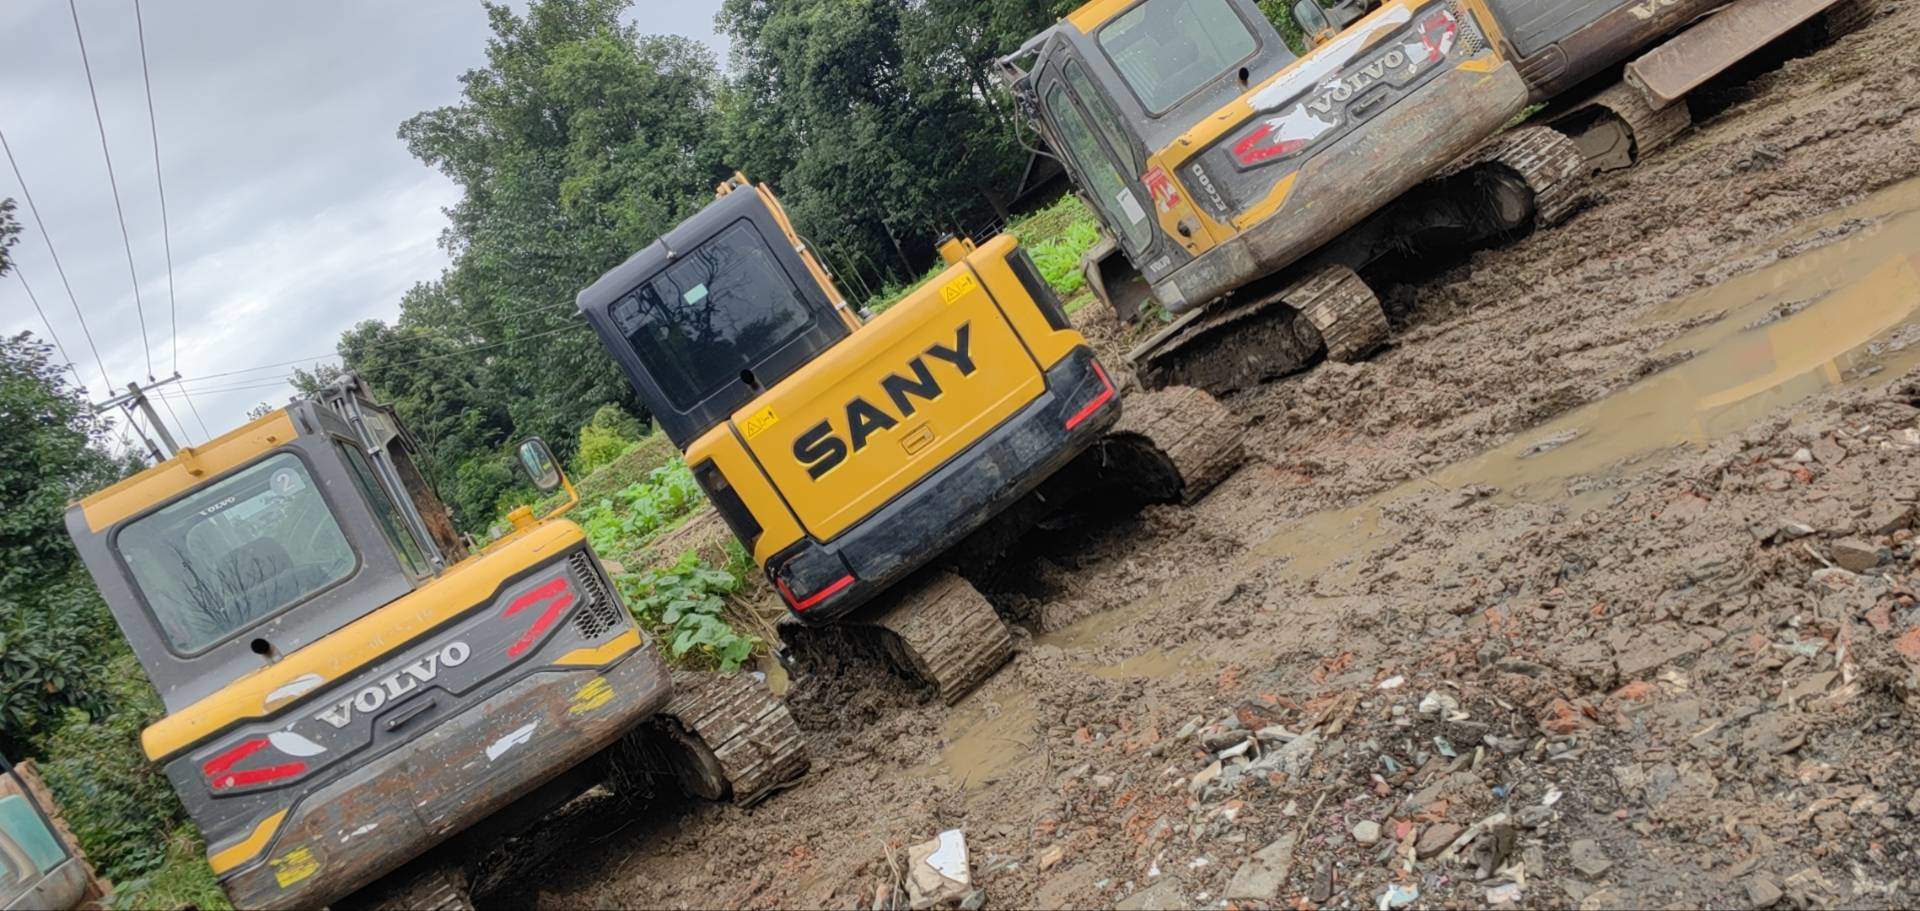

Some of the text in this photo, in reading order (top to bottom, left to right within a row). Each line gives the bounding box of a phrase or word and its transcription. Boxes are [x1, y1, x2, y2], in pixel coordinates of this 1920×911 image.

[1308, 50, 1404, 113] VOLVO
[1192, 163, 1228, 212] EC60D
[793, 320, 977, 482] SANY
[199, 496, 236, 517] VOLVO
[276, 473, 296, 493] 2
[315, 641, 471, 729] VOLVO
